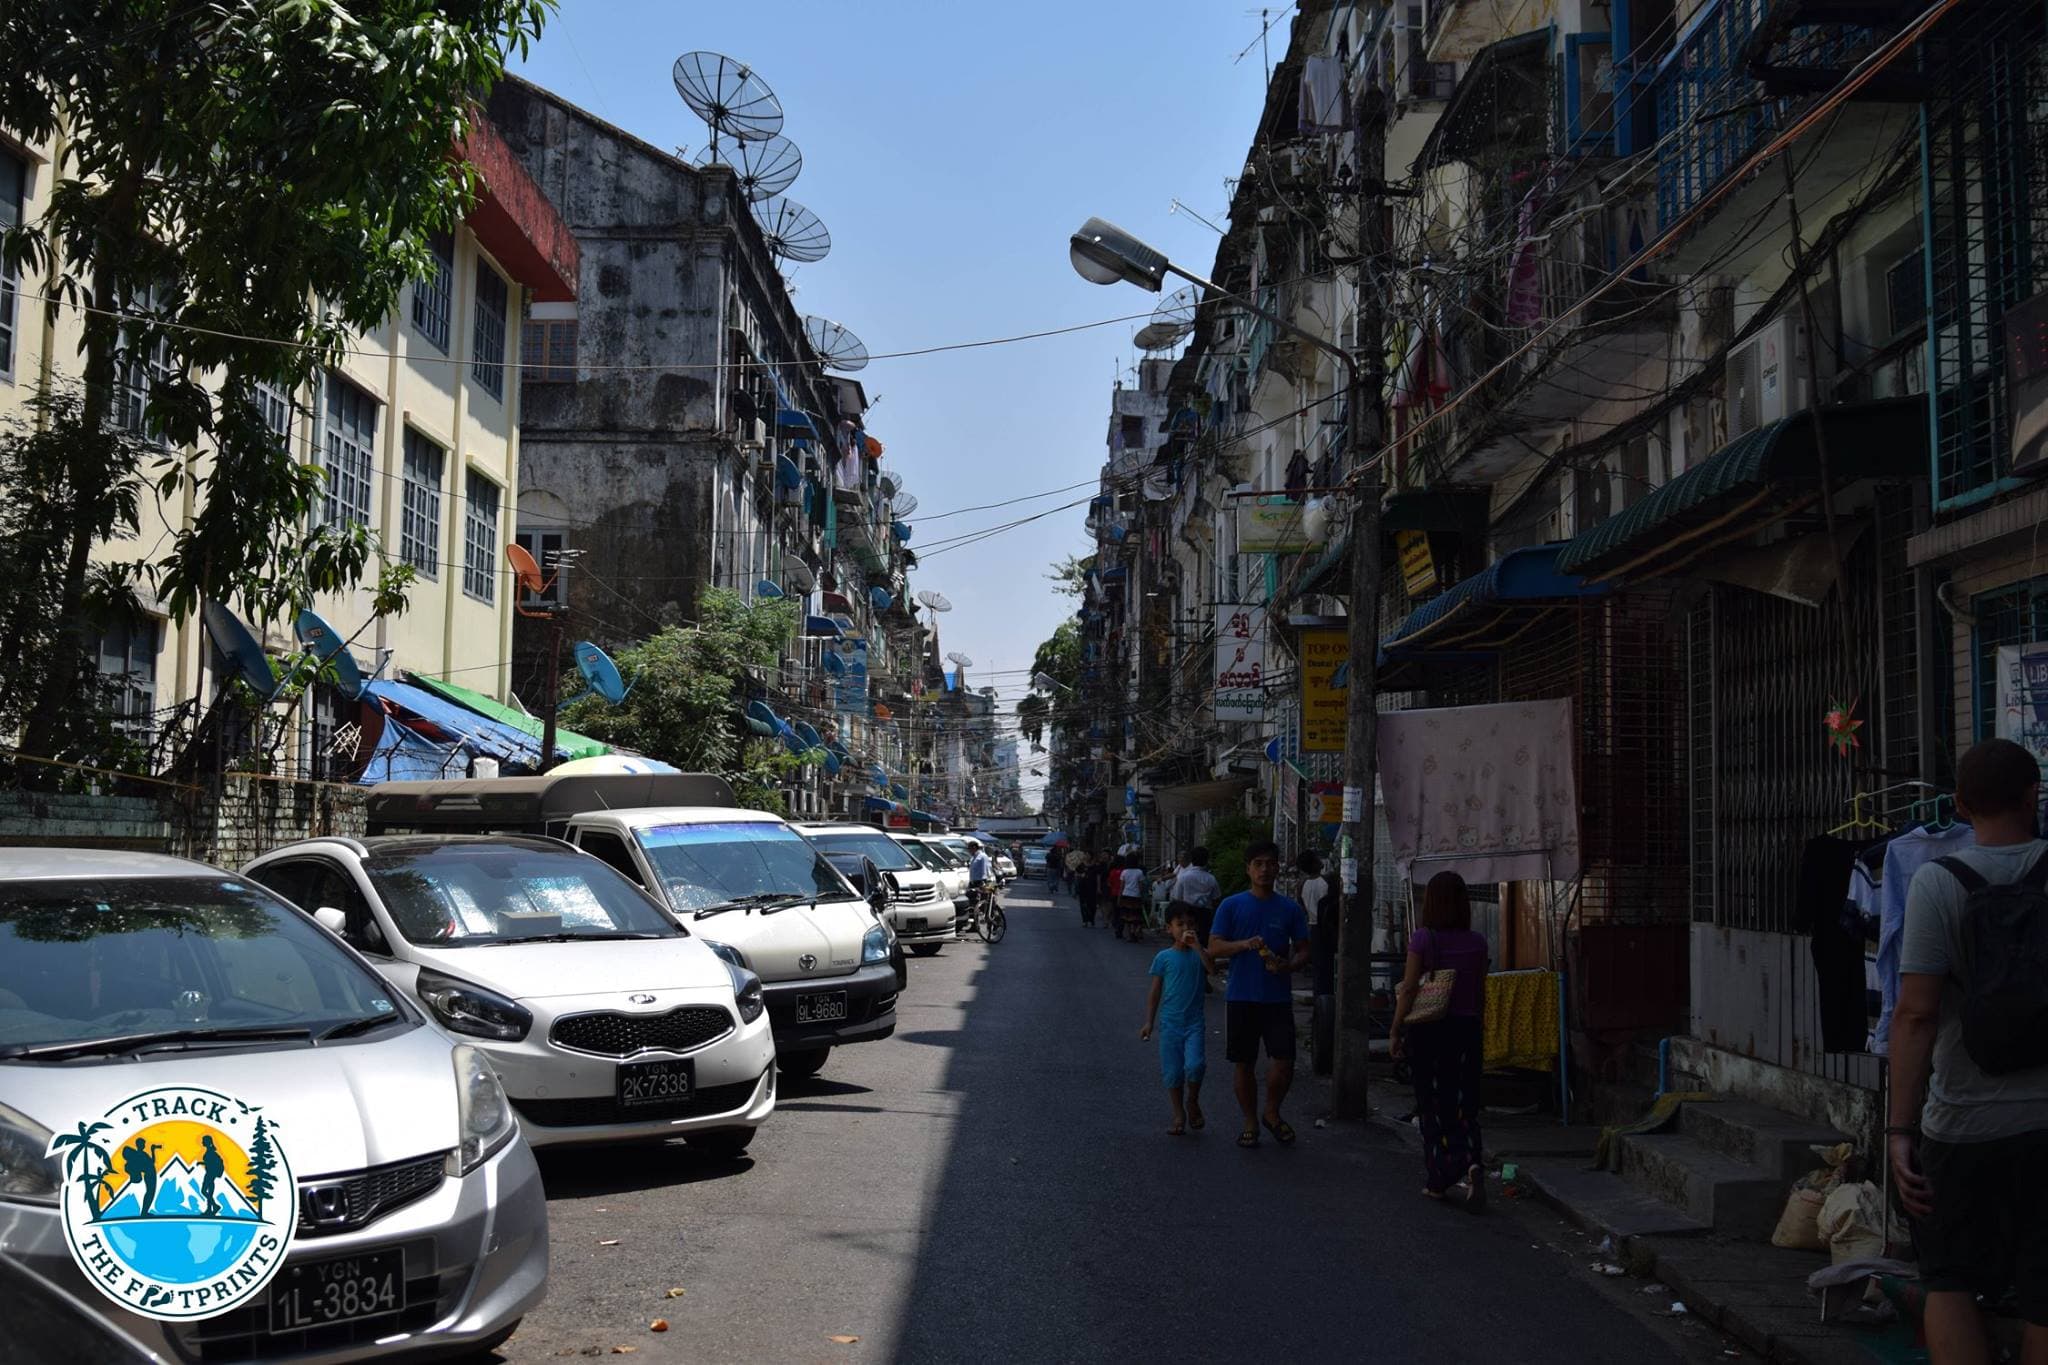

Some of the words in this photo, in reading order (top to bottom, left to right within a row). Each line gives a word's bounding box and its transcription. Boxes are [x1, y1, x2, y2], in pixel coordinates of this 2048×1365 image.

[1305, 643, 1330, 655] TOP
[1332, 643, 1348, 655] ON
[2030, 664, 2048, 683] LIB
[798, 1000, 844, 1021] 9L-9680
[644, 1063, 668, 1075] YGN
[624, 1071, 688, 1099] 2K-7338
[317, 1260, 361, 1283] YGN
[278, 1272, 396, 1327] 1L-3834
